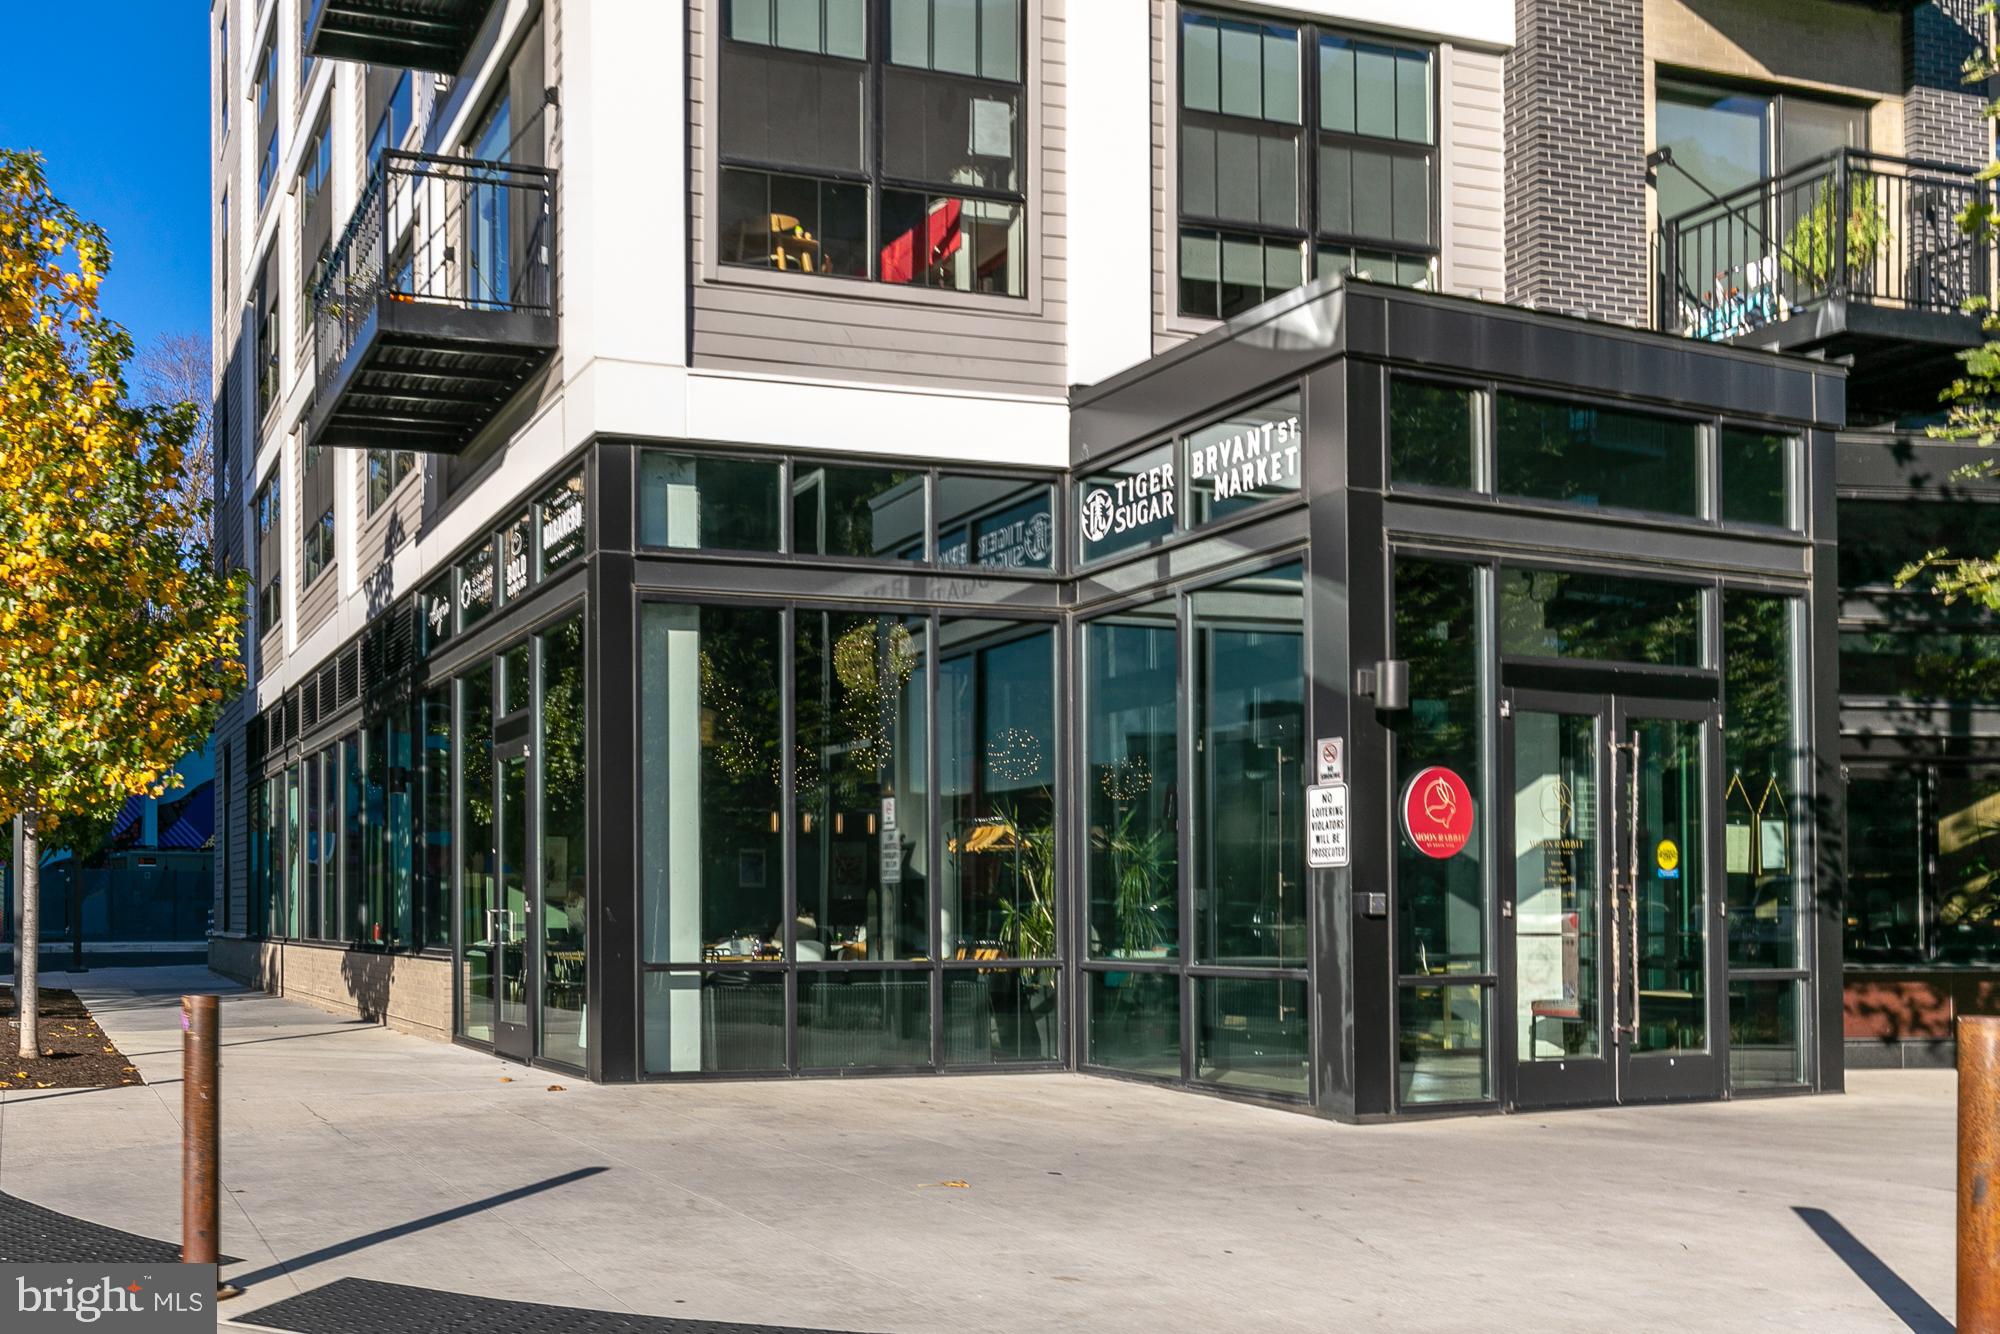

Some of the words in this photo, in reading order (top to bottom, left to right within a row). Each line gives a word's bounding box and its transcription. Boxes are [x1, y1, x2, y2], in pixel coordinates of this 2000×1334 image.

[1192, 421, 1274, 479] BRYANT
[1277, 417, 1298, 444] ST
[1214, 446, 1298, 502] MARKET
[1114, 462, 1175, 507] TIGER
[1114, 490, 1175, 534] SUGAR
[1321, 793, 1333, 804] NO
[1311, 806, 1344, 818] LOITERING
[1311, 820, 1345, 832] VIOLATORS
[1315, 834, 1330, 844] WILL
[1332, 833, 1340, 844] BE
[1415, 832, 1437, 841] MOON
[1438, 833, 1465, 843] RABBIT
[1311, 846, 1345, 858] PROSECUTED
